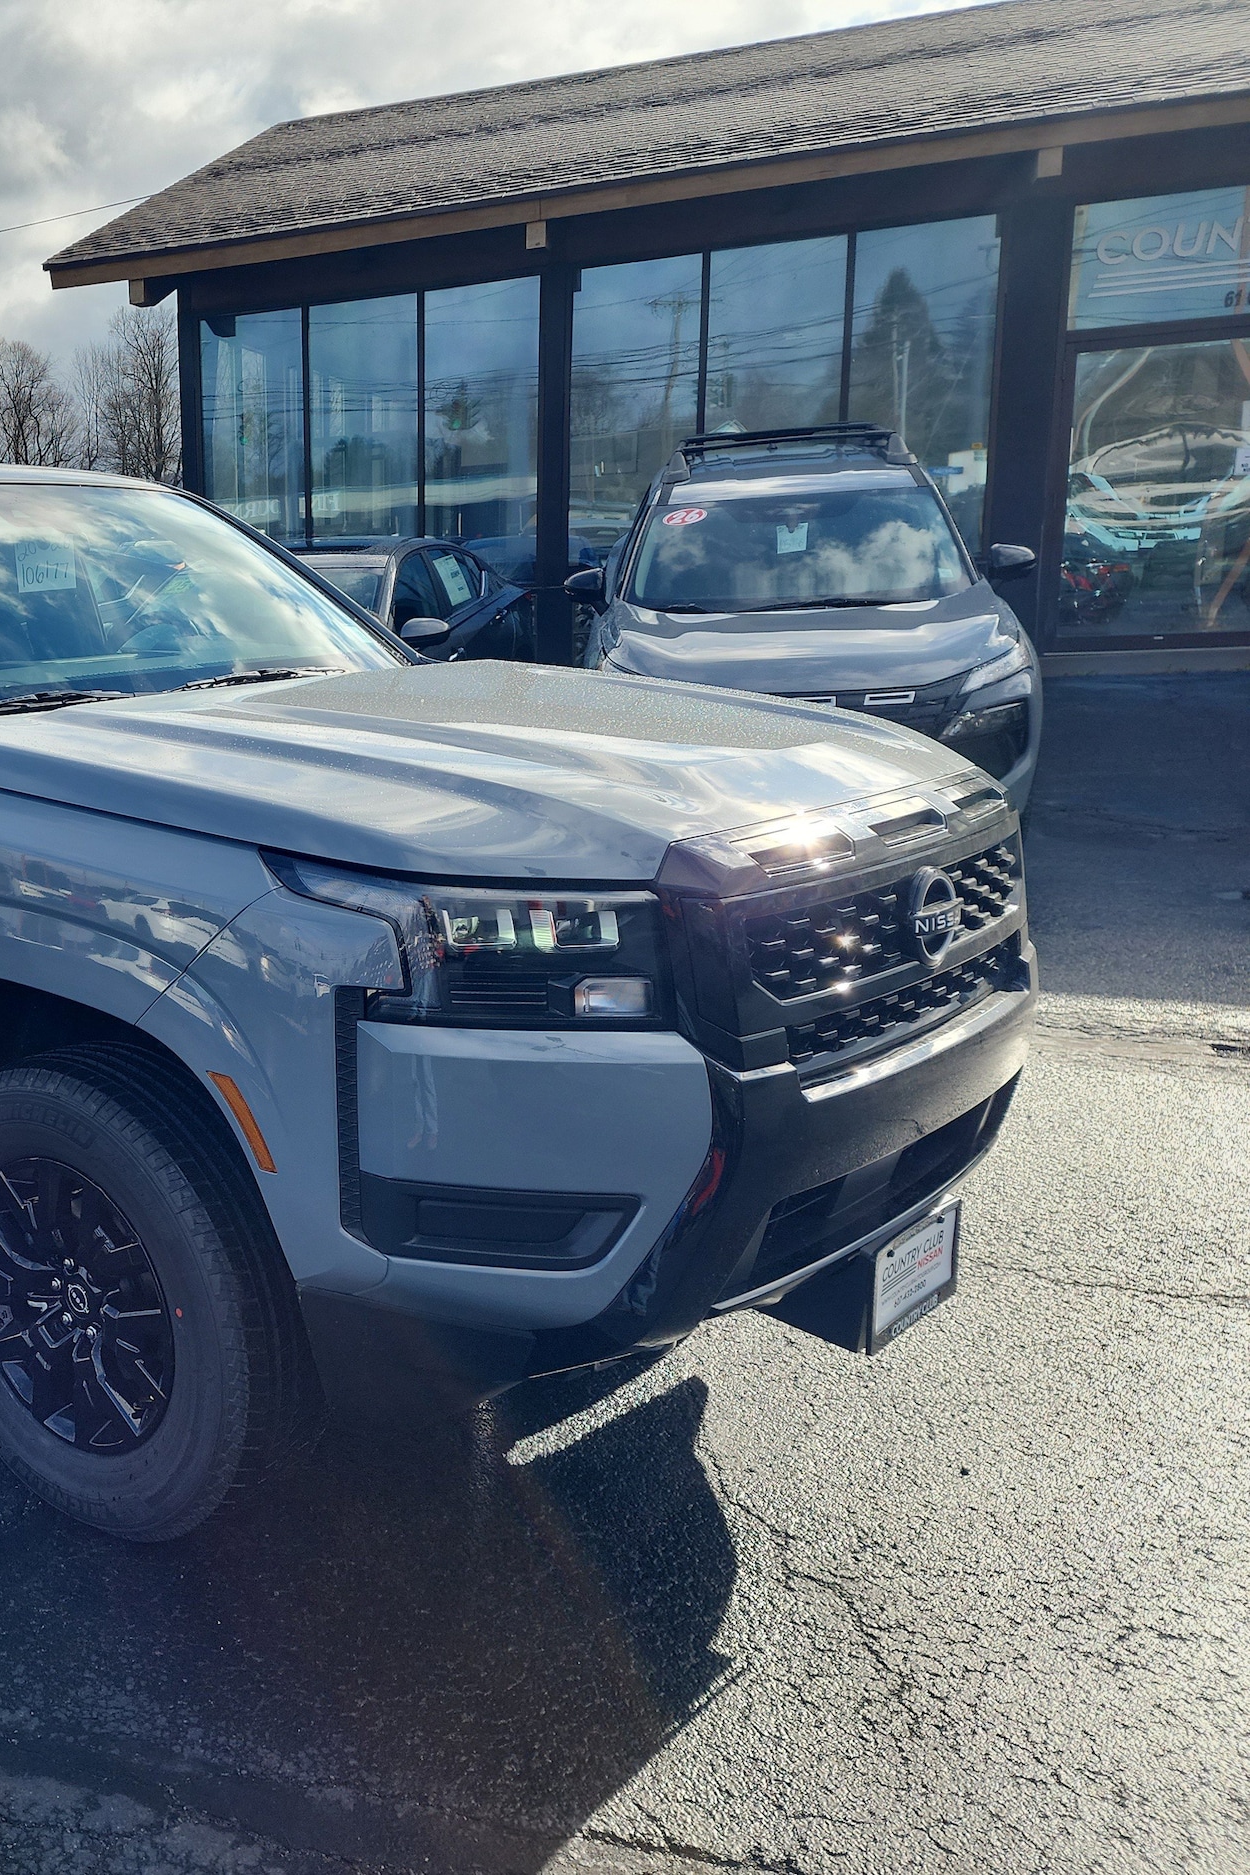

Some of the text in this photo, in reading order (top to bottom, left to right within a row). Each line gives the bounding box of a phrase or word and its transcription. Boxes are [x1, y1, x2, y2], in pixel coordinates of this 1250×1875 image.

[1097, 216, 1245, 265] COUN
[668, 509, 699, 523] 26
[22, 560, 69, 588] 106177
[915, 909, 958, 934] NISS
[0, 1102, 93, 1146] MICHELIN
[882, 1230, 944, 1282] COUNTRY CLUB
[917, 1246, 944, 1270] NISSAN
[892, 1294, 938, 1337] COUNTRY CLUB
